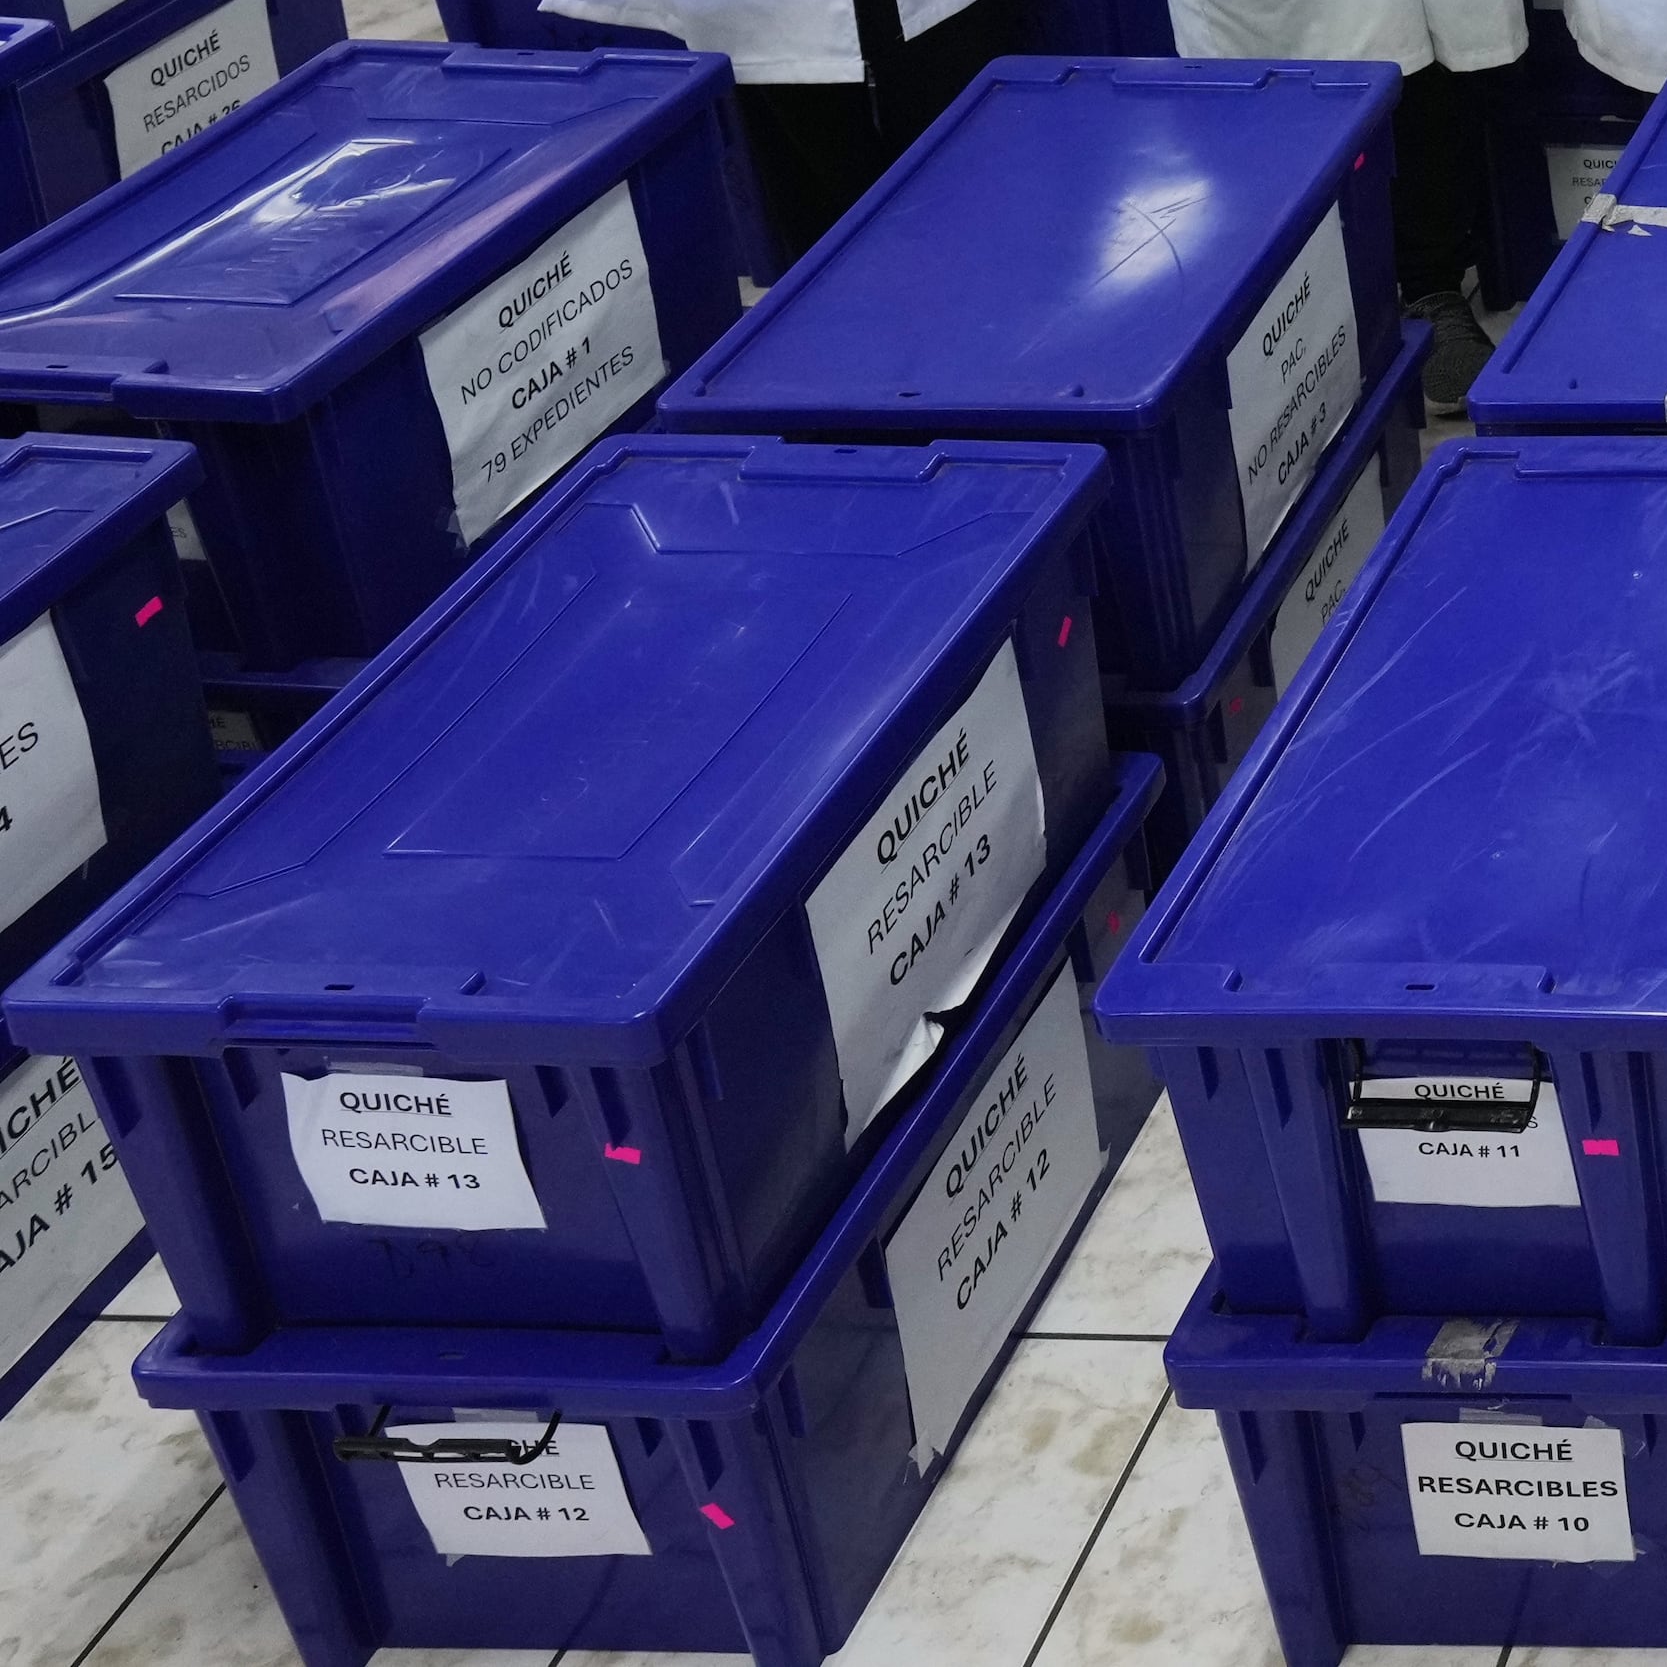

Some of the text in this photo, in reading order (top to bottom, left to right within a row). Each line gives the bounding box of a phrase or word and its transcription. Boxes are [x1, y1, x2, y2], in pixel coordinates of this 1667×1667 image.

[498, 253, 573, 331] QUICHÉ
[1261, 273, 1312, 357] QUICHÉ
[460, 259, 633, 405] NO CODIFICADOS
[511, 336, 592, 410] CAJA # 1
[1247, 324, 1347, 485] NO RESARCIBLES
[481, 346, 634, 483] 79 EXPEDIENTES
[1276, 402, 1327, 486] CAJA # 3
[876, 727, 970, 866] QUICHÉ
[867, 760, 997, 955] RESARCIBLE
[890, 834, 991, 986] CAJA # 13
[339, 1093, 452, 1116] QUICHÉ
[946, 1052, 1028, 1198] QUICHÉ
[1414, 1082, 1505, 1099] QUICHÉ
[321, 1128, 488, 1155] RESARCIBLE
[349, 1168, 481, 1190] CAJA # 13
[937, 1073, 1057, 1282] RESARCIBLE
[1418, 1142, 1520, 1158] CAJA # 11
[956, 1149, 1051, 1310] CAJA # 12
[434, 1473, 596, 1490] RESARCIBLE
[1417, 1475, 1618, 1497] RESARCIBLES
[1455, 1439, 1573, 1461] QUICHÉ
[463, 1506, 590, 1521] CAJA # 12
[1454, 1512, 1590, 1532] CAJA # 10
